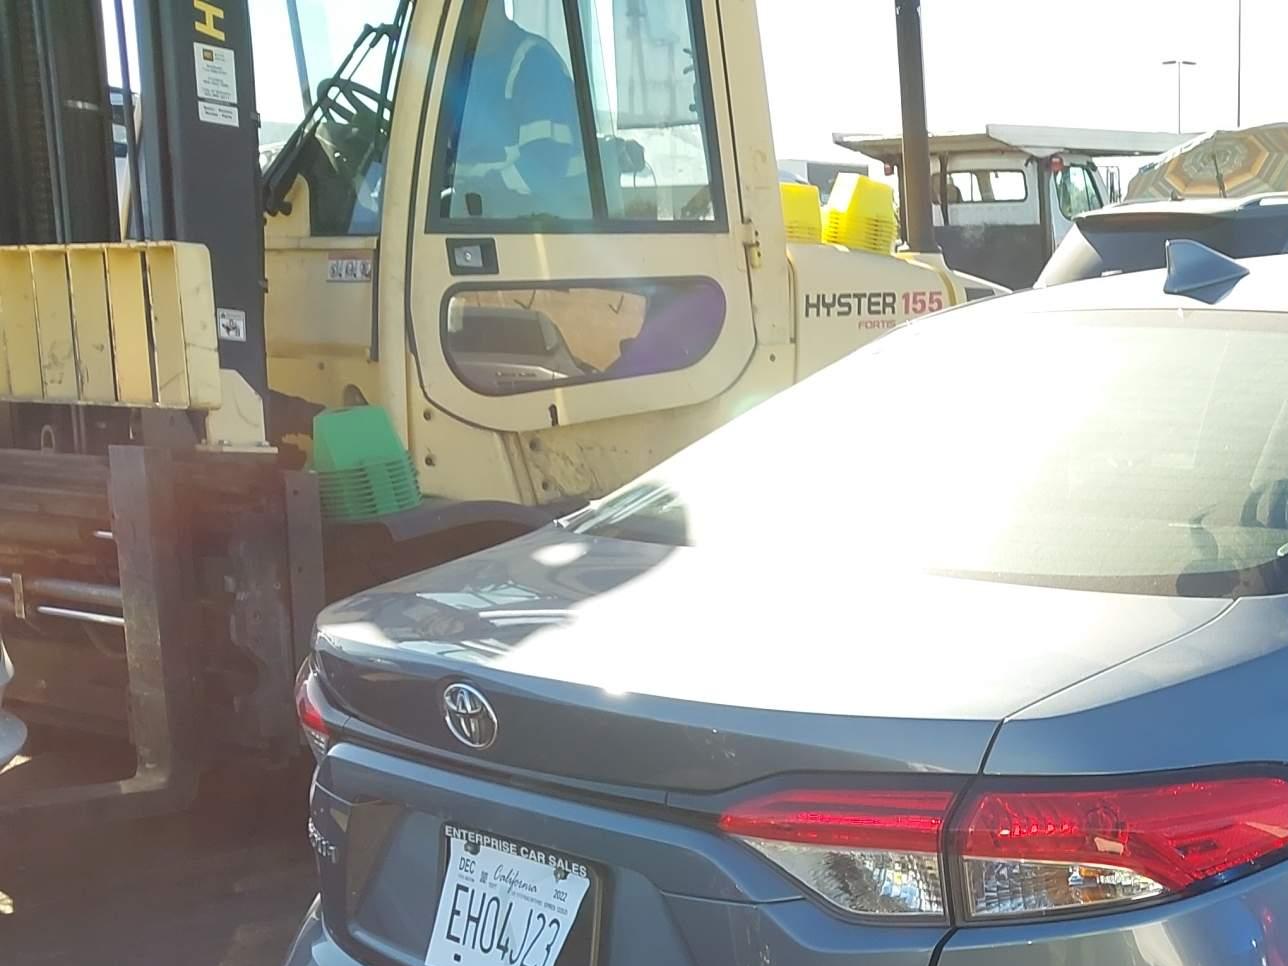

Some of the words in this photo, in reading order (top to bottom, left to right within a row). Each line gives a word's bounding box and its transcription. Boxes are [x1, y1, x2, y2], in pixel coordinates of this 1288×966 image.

[804, 292, 897, 318] HYSTER
[901, 291, 944, 315] 155
[858, 319, 897, 330] FORTIS
[445, 825, 517, 856] ENTERPRISE
[520, 847, 546, 864] CAR
[549, 856, 588, 878] SALES
[458, 856, 477, 876] DEC
[493, 864, 538, 894] California
[553, 888, 568, 902] 2022
